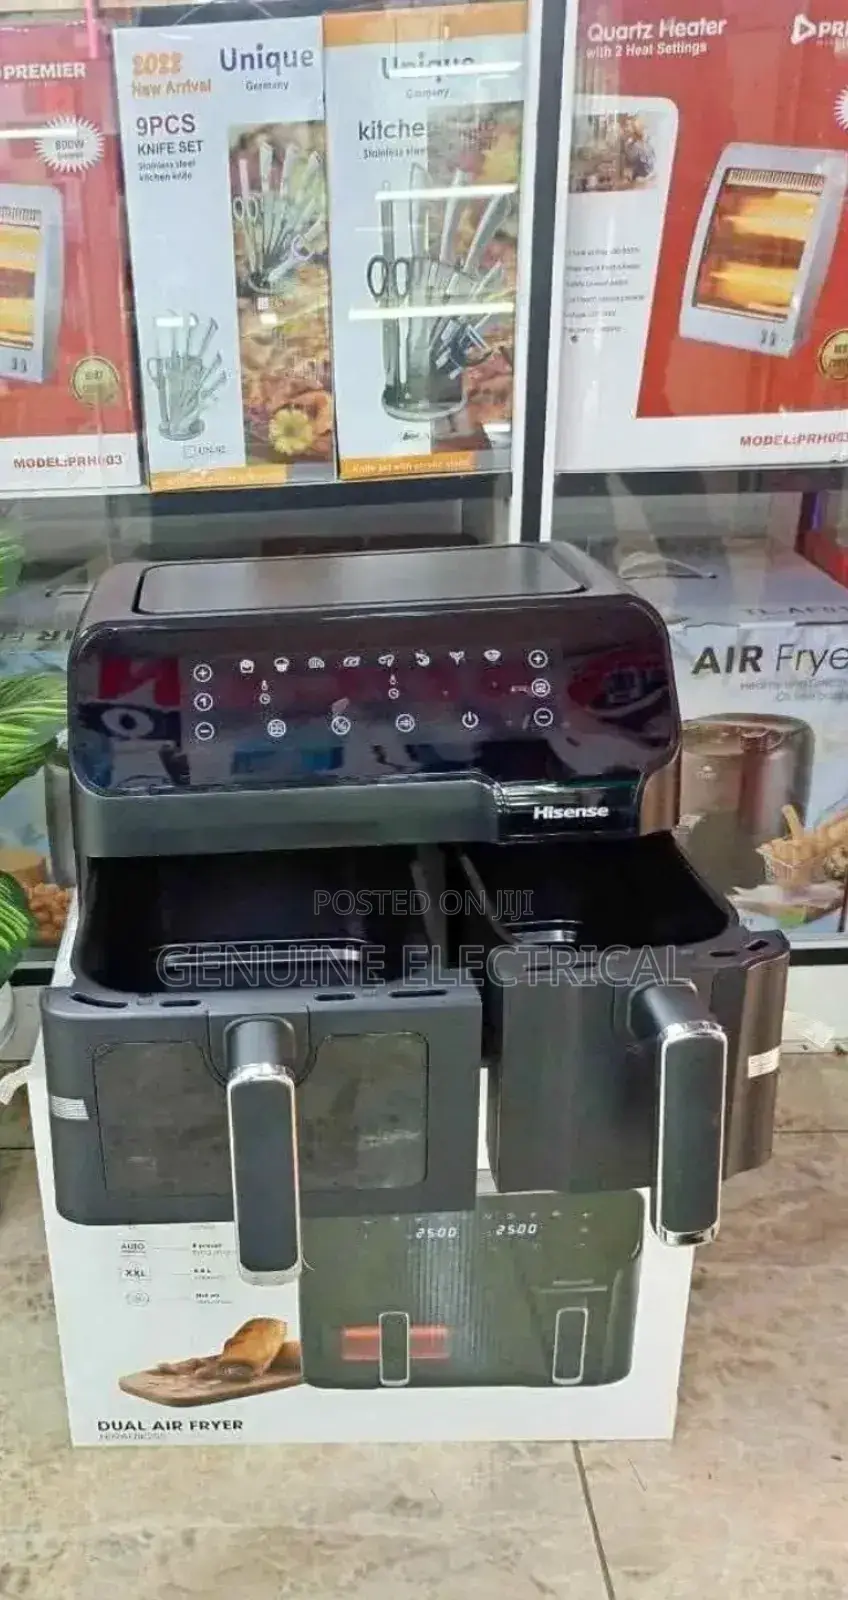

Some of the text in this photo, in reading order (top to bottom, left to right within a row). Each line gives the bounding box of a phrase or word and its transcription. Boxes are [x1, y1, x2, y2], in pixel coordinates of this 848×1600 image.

[587, 17, 728, 42] Quartz Heater
[818, 20, 848, 38] PR
[586, 40, 707, 59] with 2 Heat Settings
[132, 52, 183, 77] 2022
[219, 43, 314, 76] Unique
[3, 62, 86, 80] PREMIER
[166, 78, 212, 95] Arrival
[245, 80, 289, 92] Germany
[136, 113, 196, 136] 9PCS
[137, 139, 204, 156] KNIFE SET
[691, 644, 763, 675] AIR
[533, 805, 609, 820] Hisense
[97, 1420, 243, 1432] DUAL AIR FRYER
